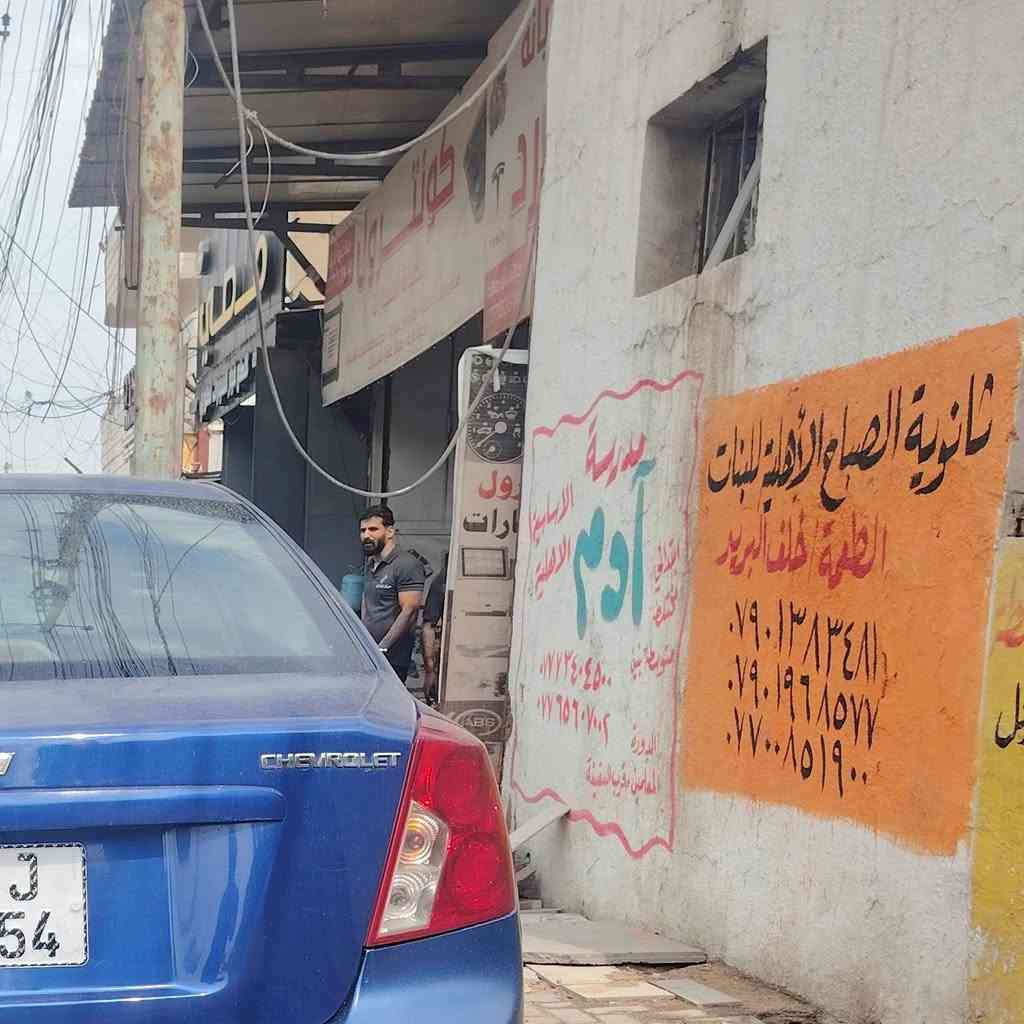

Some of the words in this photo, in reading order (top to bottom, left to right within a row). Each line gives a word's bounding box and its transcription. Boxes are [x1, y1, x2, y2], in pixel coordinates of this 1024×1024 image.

[585, 414, 647, 488] مدرسة
[708, 418, 762, 504] للبنات
[820, 384, 902, 512] الصباح
[905, 372, 993, 494] ثانوية
[573, 457, 657, 640] آدم
[716, 514, 766, 579] البريد
[767, 507, 808, 573] خلف
[729, 599, 876, 684] ٠٧٩٠١٣٨٣٤٨١
[728, 654, 880, 749] ٠٧٩٠١٩٦٨٥٧٧
[260, 752, 401, 769] CHEVROLET
[727, 707, 867, 798] ٠٧٧٠٠٨٥١٩٠٠
[9, 852, 39, 902] J
